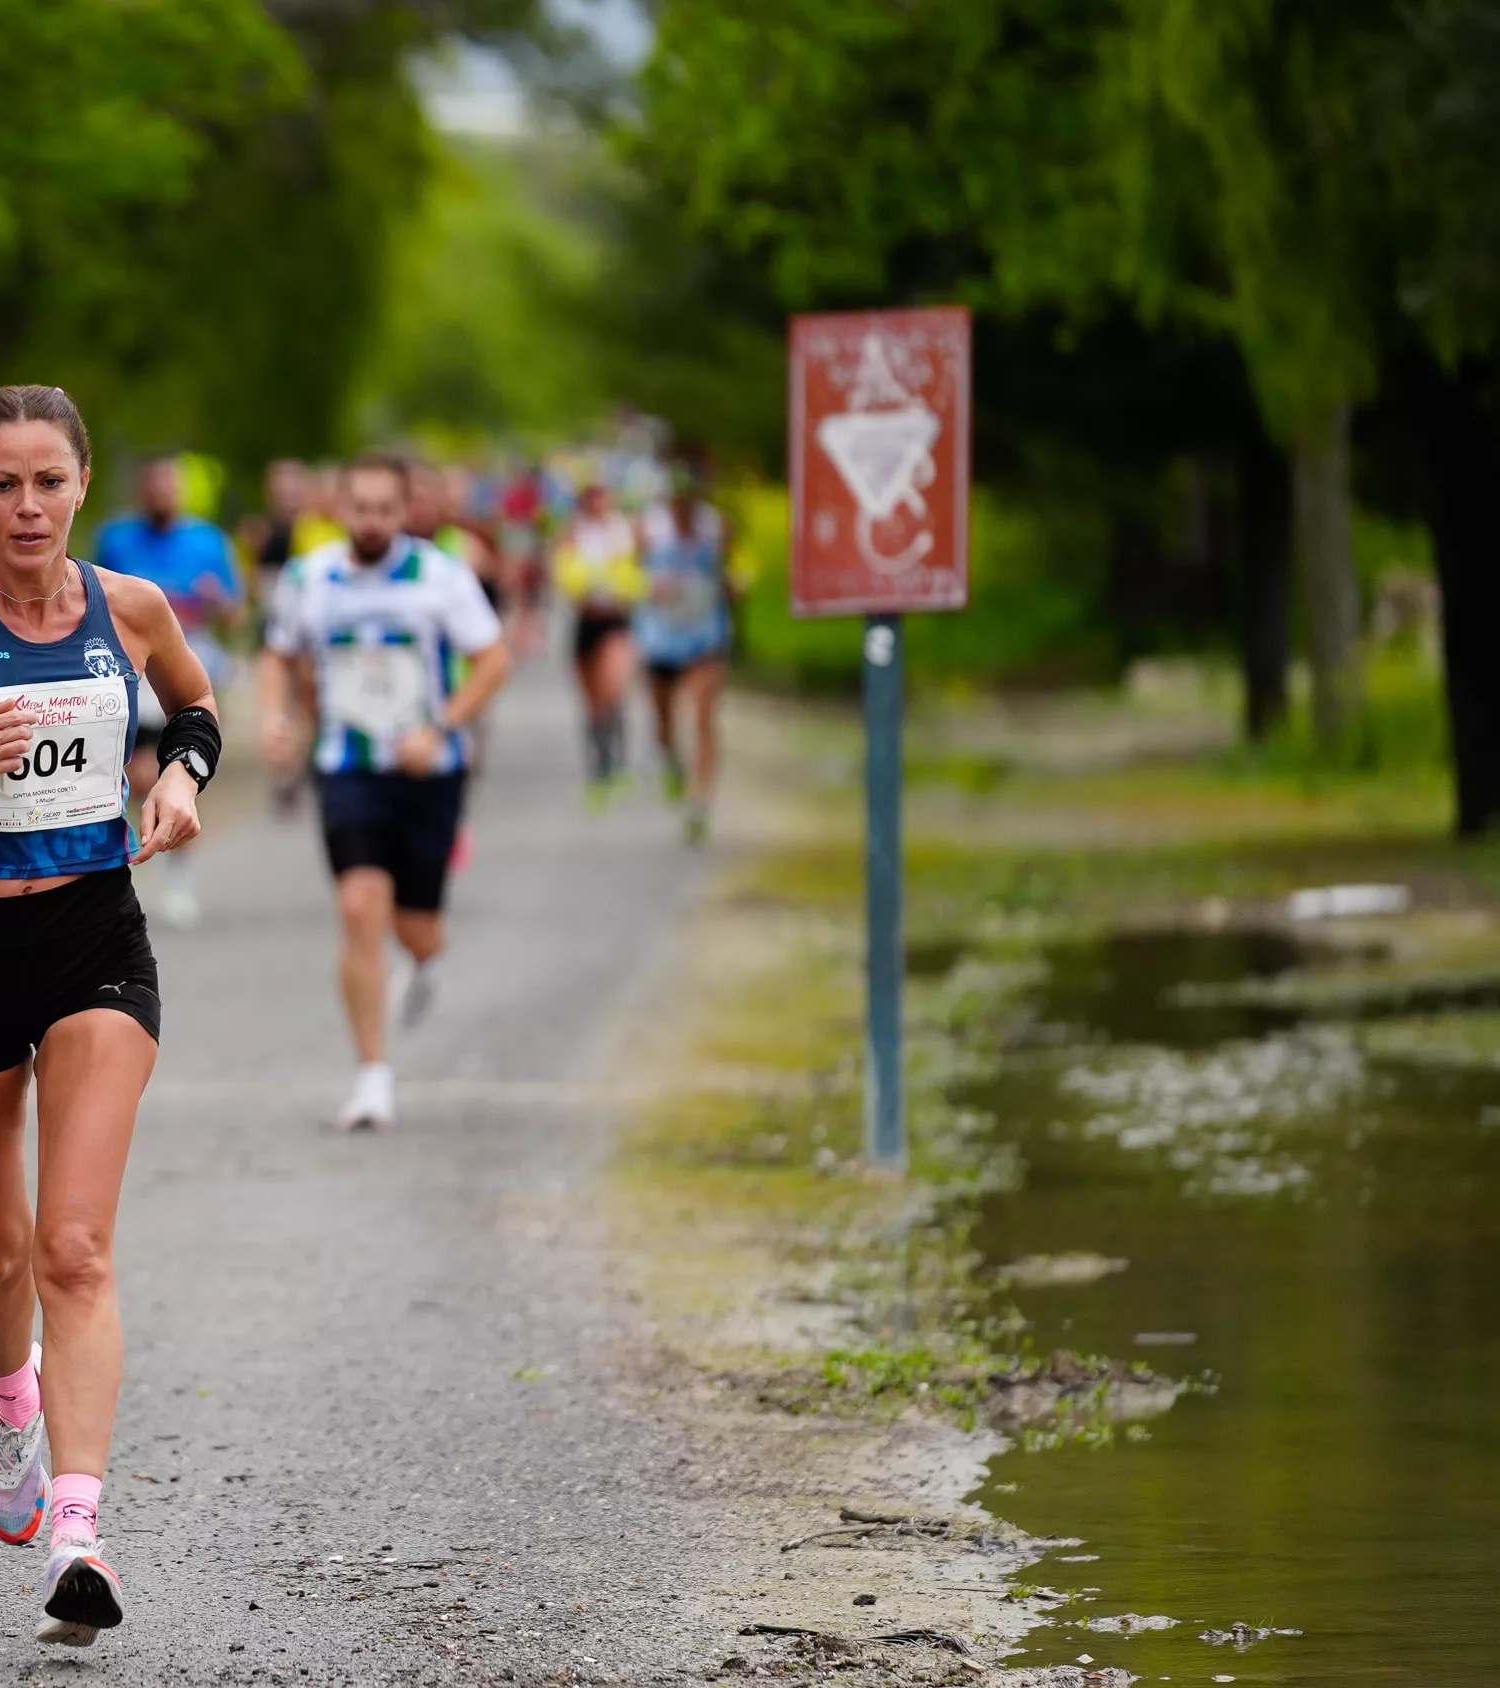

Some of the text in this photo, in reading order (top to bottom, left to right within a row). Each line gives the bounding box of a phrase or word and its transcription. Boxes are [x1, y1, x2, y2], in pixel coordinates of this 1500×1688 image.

[29, 711, 79, 726] UCENA
[12, 791, 31, 799] CINTIA
[32, 788, 57, 797] MORENO
